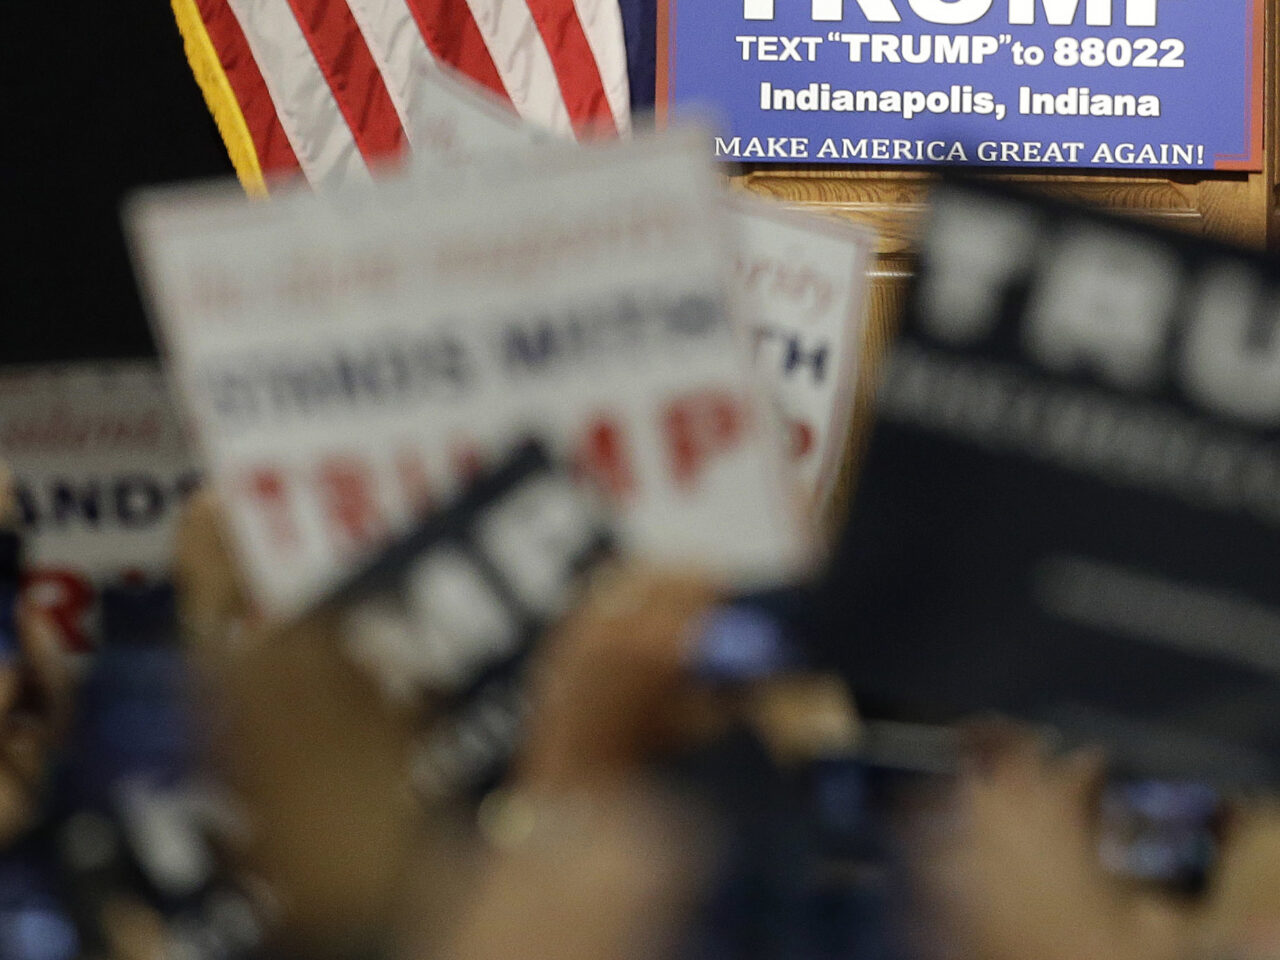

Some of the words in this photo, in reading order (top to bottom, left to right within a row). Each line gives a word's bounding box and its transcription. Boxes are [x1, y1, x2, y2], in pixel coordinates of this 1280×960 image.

[735, 35, 823, 62] TEXT
[1011, 40, 1045, 66] to
[1053, 36, 1185, 68] 88022
[760, 82, 1007, 120] Indianapolis,
[1019, 86, 1161, 117] Indiana
[714, 137, 808, 158] MAKE
[816, 138, 968, 161] AMERICA
[977, 141, 1084, 163] GREAT
[1091, 143, 1205, 165] AGAIN!
